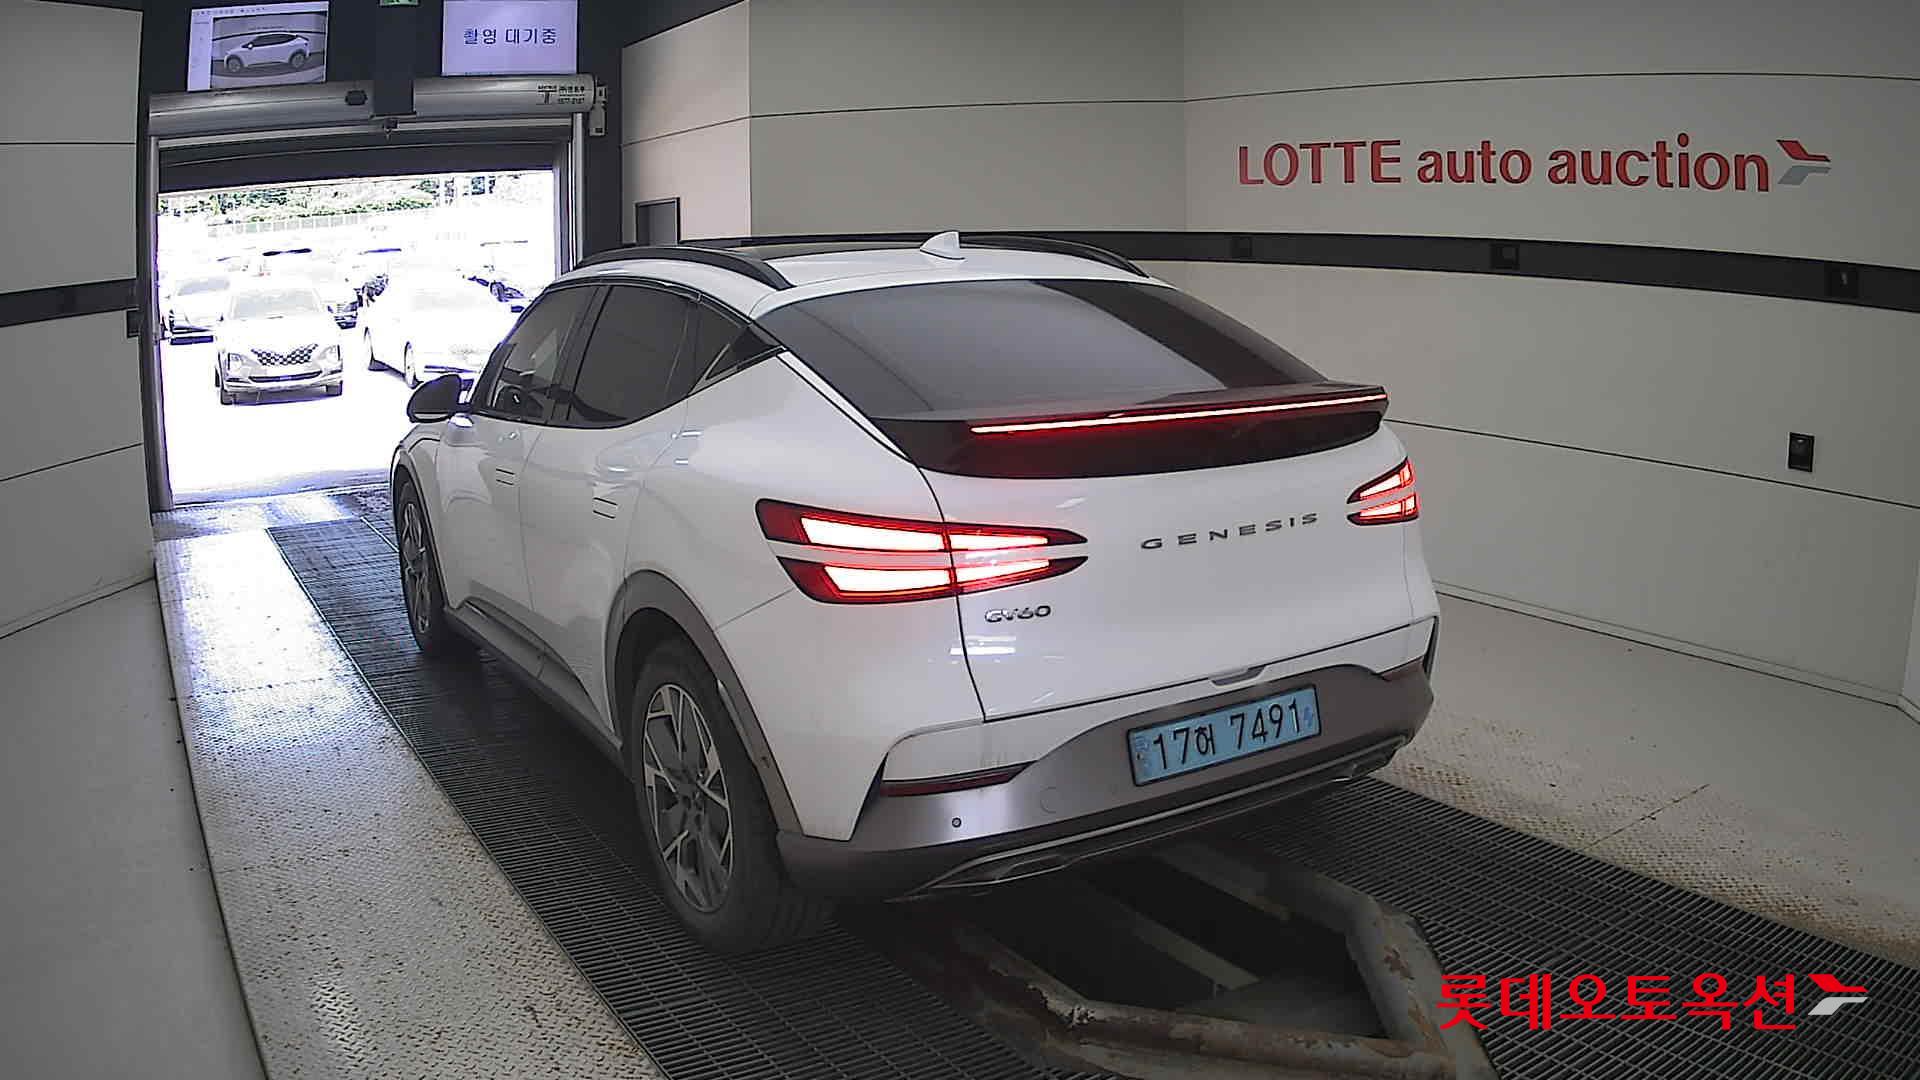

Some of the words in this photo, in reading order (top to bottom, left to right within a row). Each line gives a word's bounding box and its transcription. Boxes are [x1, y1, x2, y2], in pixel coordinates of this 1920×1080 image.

[505, 28, 556, 45] 대기중
[1239, 139, 1402, 186] LOTTE
[1417, 140, 1532, 184] auto
[1547, 133, 1770, 192] auction
[1140, 512, 1319, 550] GENESIS
[985, 605, 1051, 623] GV60
[1153, 723, 1216, 770] 17허
[1230, 698, 1300, 750] 7491
